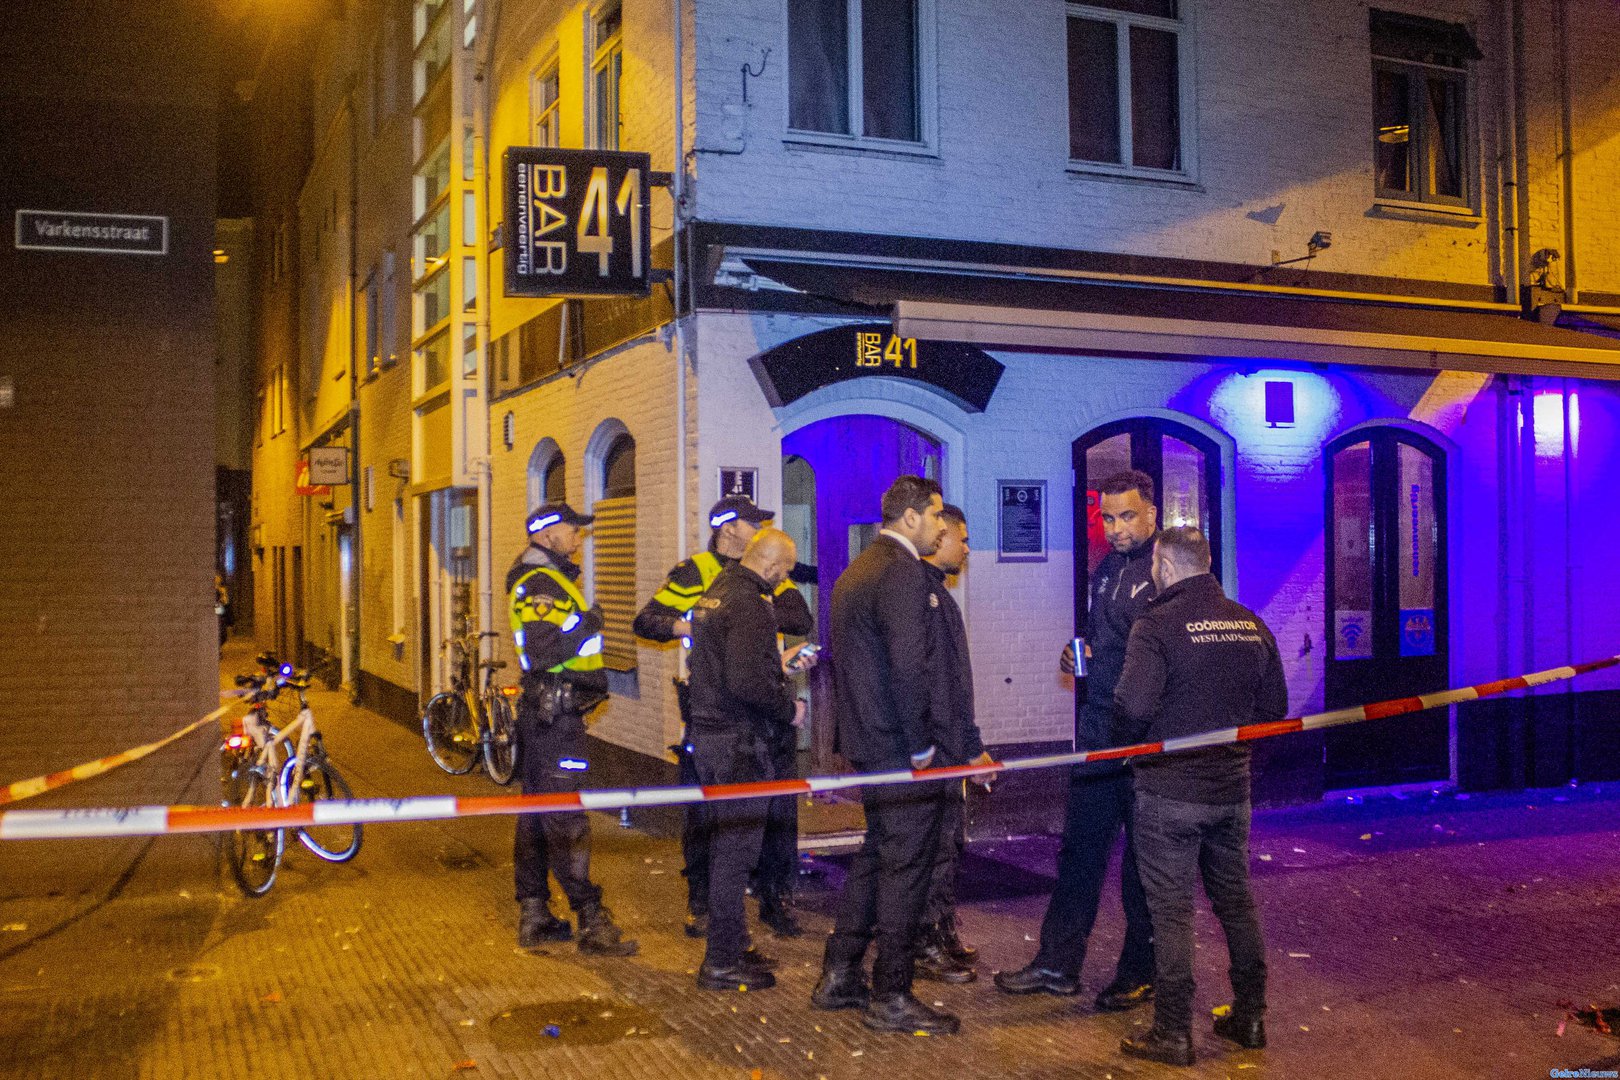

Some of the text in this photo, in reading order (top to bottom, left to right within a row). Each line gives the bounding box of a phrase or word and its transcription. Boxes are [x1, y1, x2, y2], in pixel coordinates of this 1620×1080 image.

[34, 219, 151, 241] Varkensstraat
[516, 162, 529, 275] eenenveertig
[533, 163, 642, 278] BAR 41
[864, 332, 918, 369] BAR 41
[1191, 634, 1238, 643] WESTLAND
